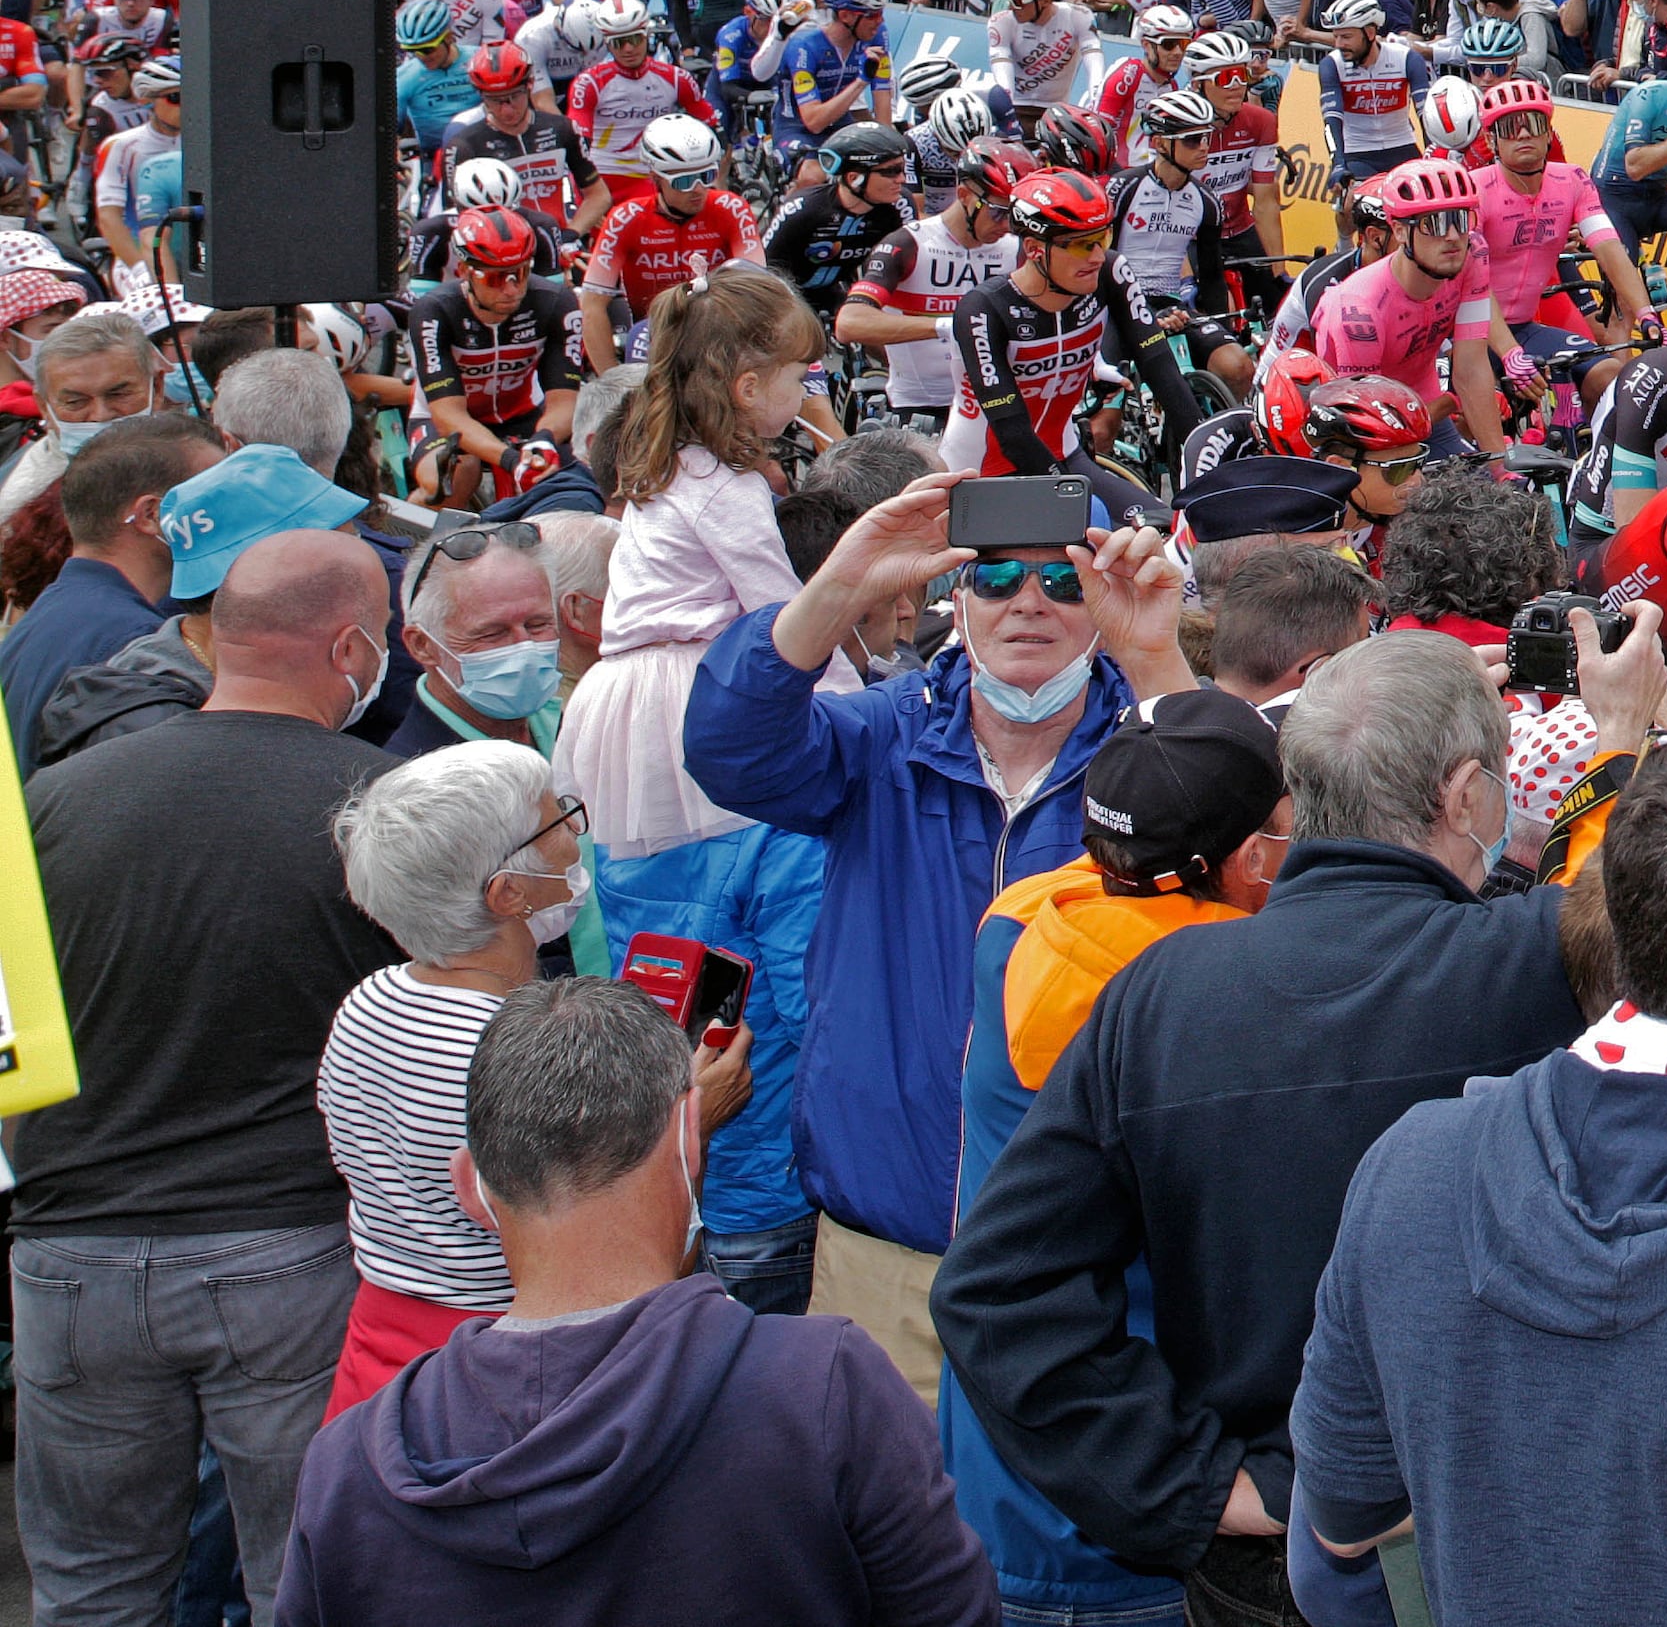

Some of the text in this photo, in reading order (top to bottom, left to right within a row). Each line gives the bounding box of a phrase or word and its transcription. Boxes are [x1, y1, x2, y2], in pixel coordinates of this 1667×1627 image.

[1344, 81, 1402, 92] TREK
[597, 202, 644, 270] ARKEA
[715, 194, 757, 254] ARKEA
[1147, 223, 1197, 236] EXCHANGE
[1151, 213, 1171, 223] BIKE
[969, 313, 1000, 387] SOUDAL
[1633, 369, 1664, 408] ALULA
